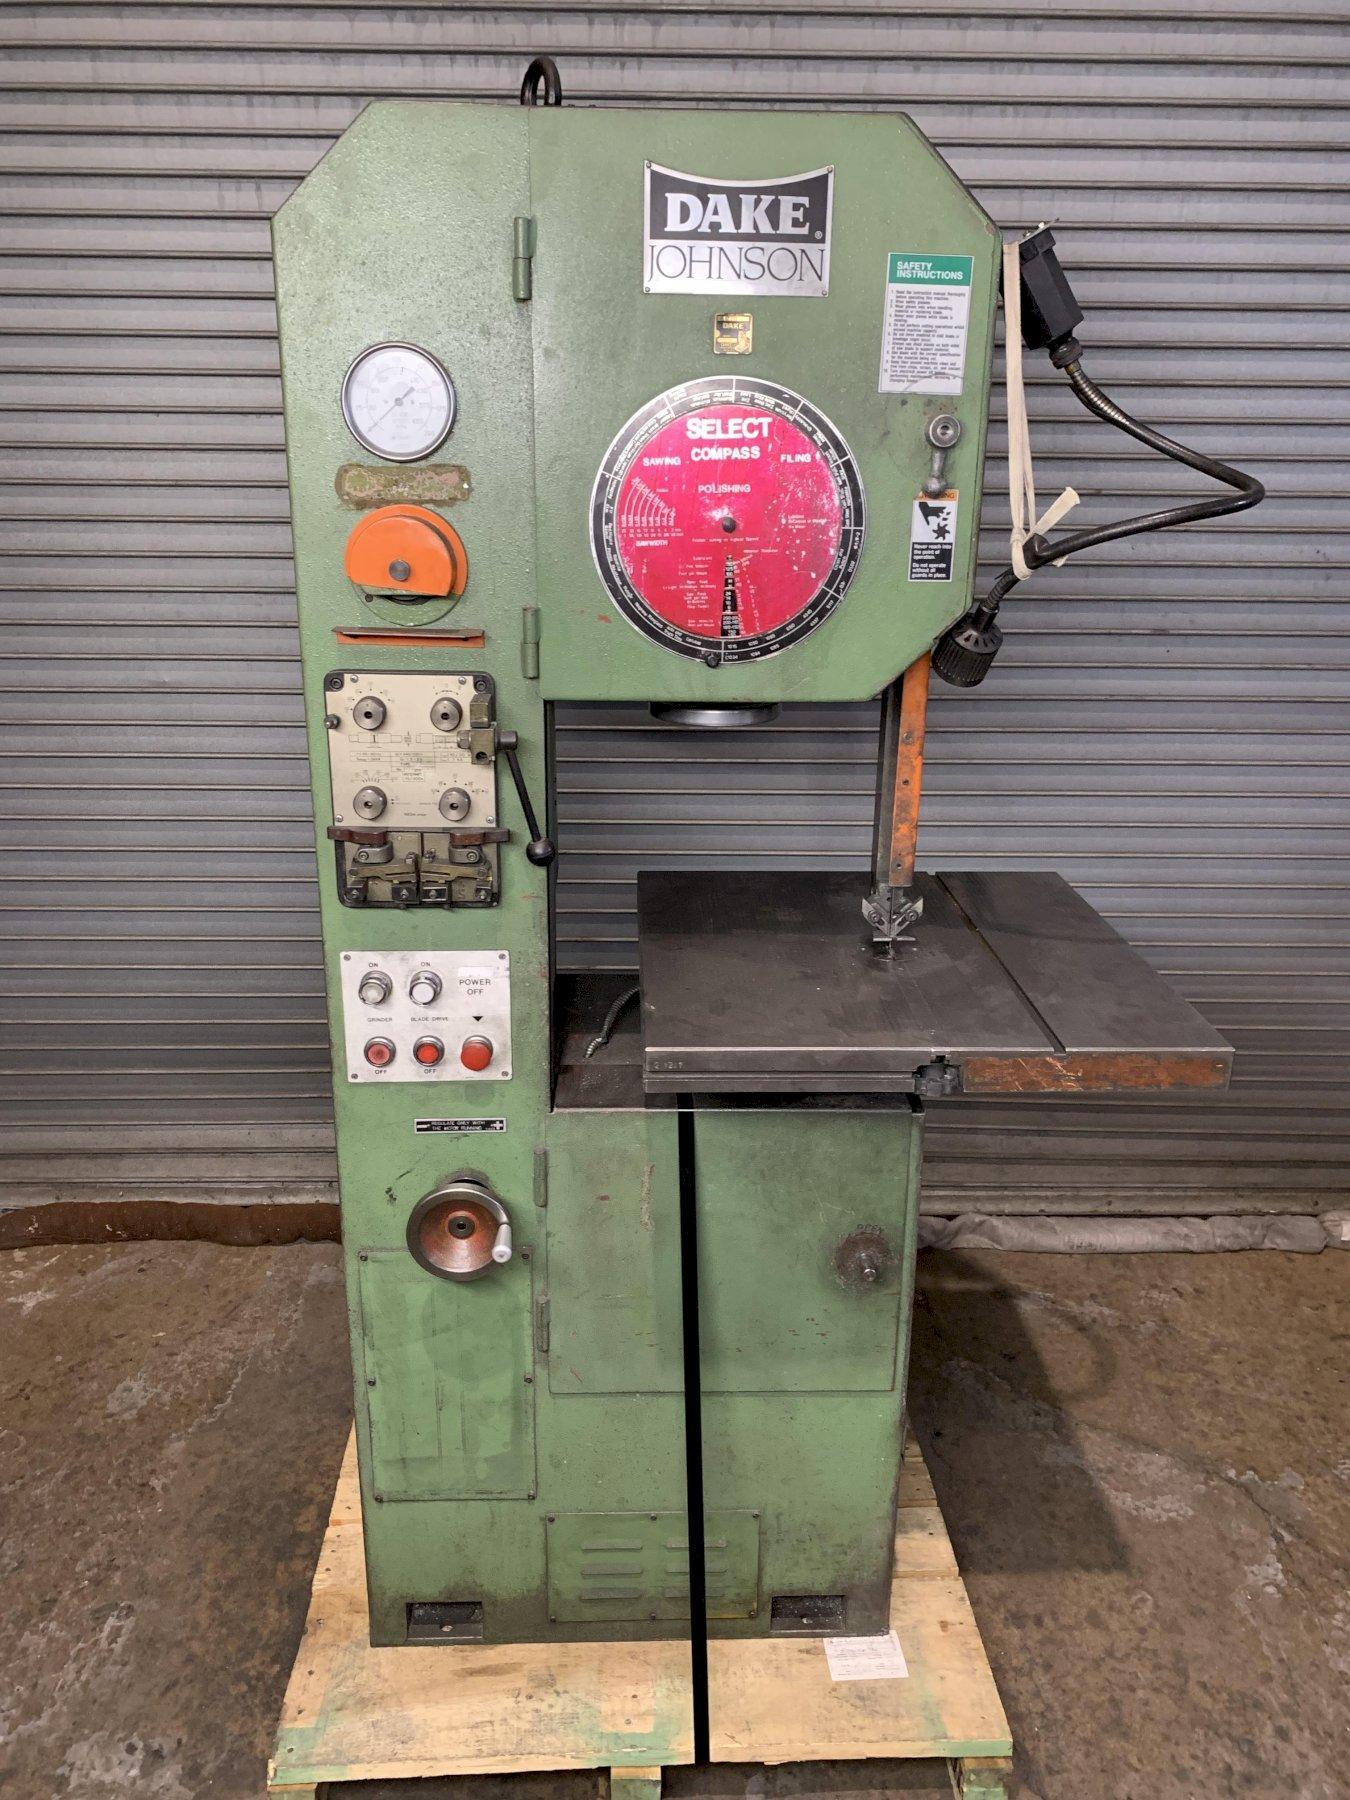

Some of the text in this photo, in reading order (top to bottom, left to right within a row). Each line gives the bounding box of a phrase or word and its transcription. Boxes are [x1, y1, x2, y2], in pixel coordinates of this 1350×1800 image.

[664, 192, 810, 235] DAKE
[648, 244, 826, 283] JOHNSON
[896, 261, 933, 270] SAFETY
[896, 270, 964, 280] INSTRUCTIONS
[686, 417, 773, 440] SELECT
[690, 445, 761, 462] COMPASS
[780, 453, 812, 463] FILING
[642, 456, 682, 467] SAWING
[698, 482, 751, 494] POLISHING
[459, 978, 491, 986] POWER
[466, 988, 484, 996] OFF
